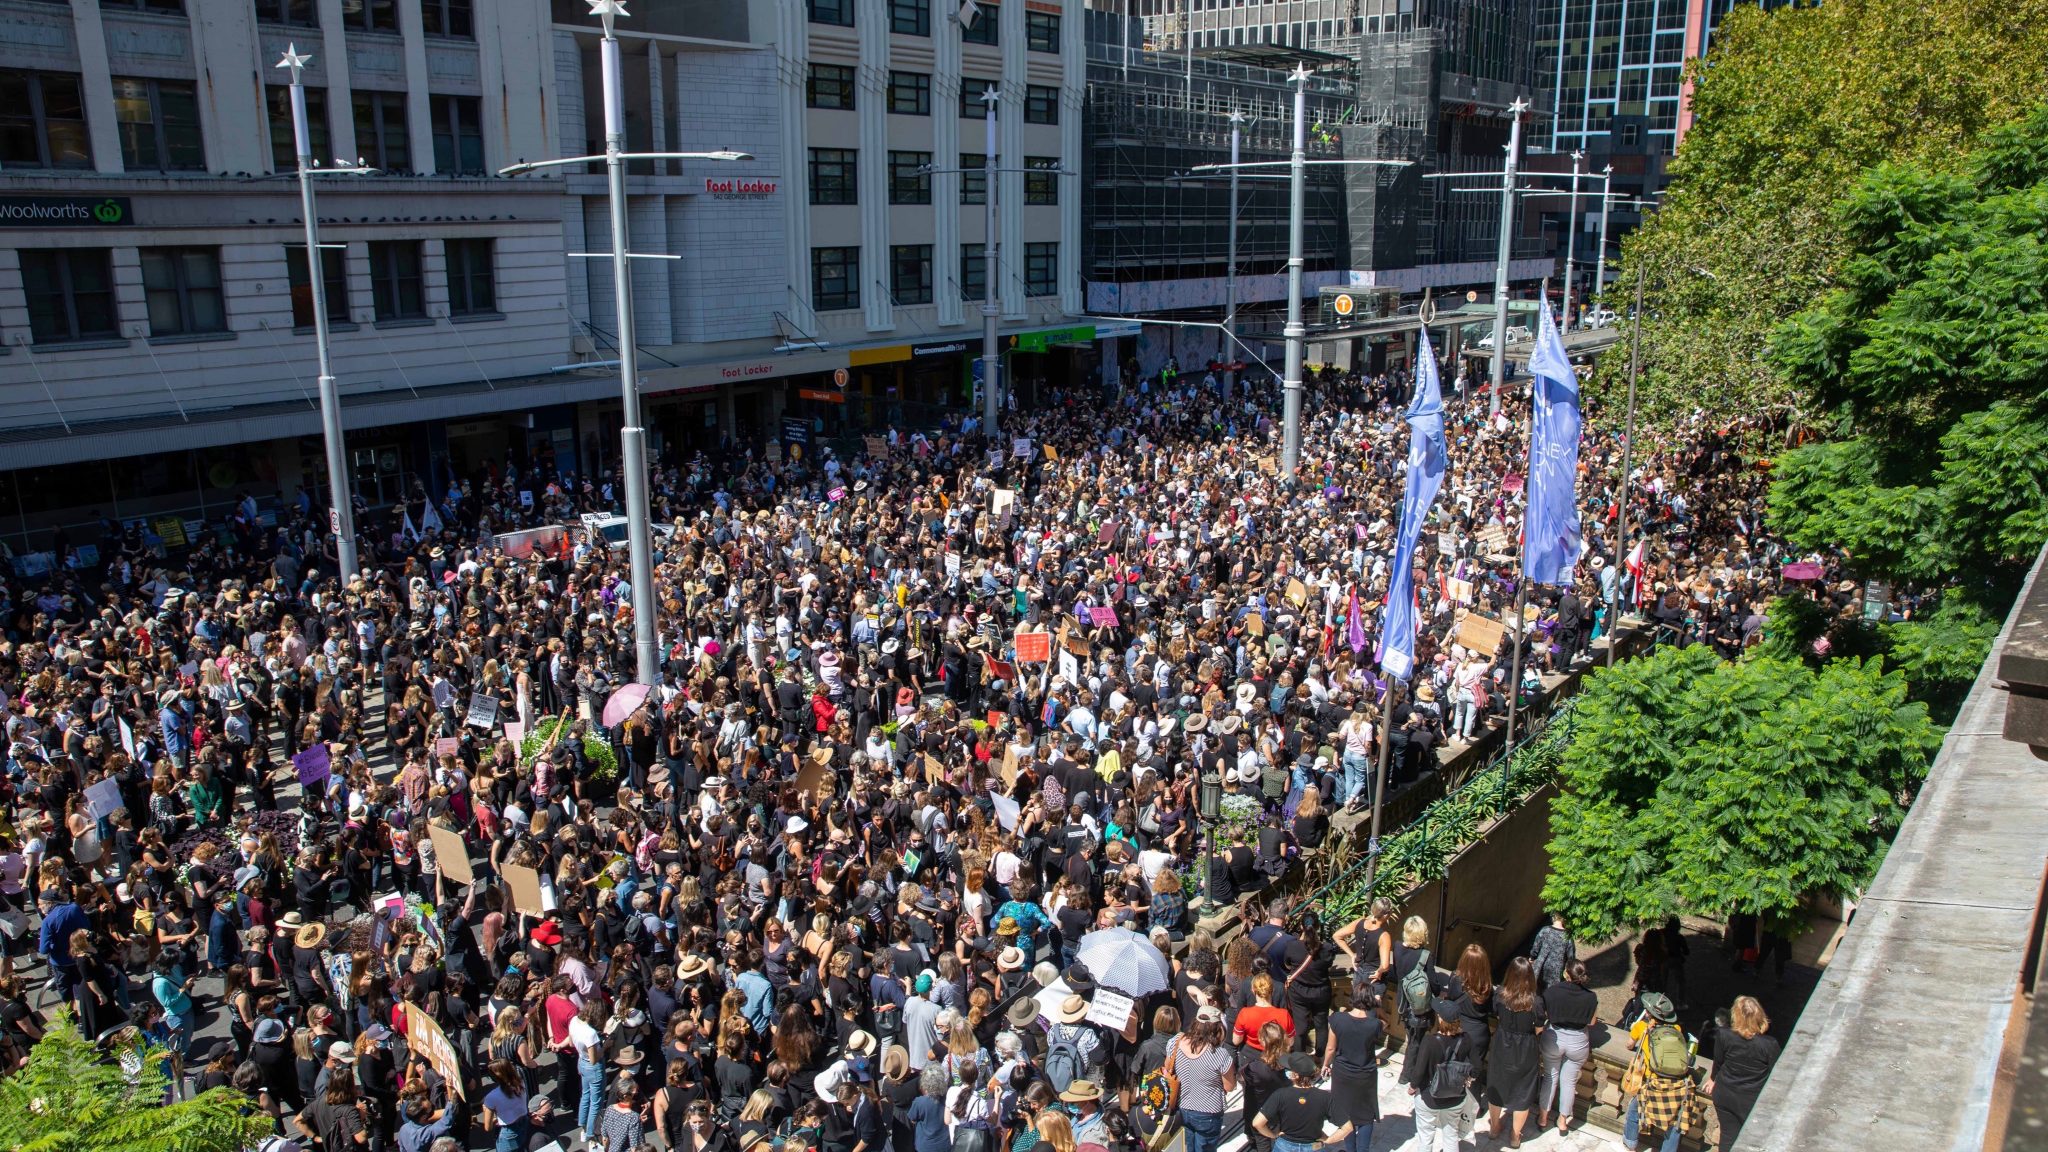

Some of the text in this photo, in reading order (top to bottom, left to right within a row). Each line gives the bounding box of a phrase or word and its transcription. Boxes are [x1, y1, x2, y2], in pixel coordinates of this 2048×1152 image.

[706, 179, 777, 193] Foot Locker
[0, 203, 89, 219] Woolworths
[914, 344, 955, 355] Commonwealth
[722, 364, 774, 378] Foot Locker
